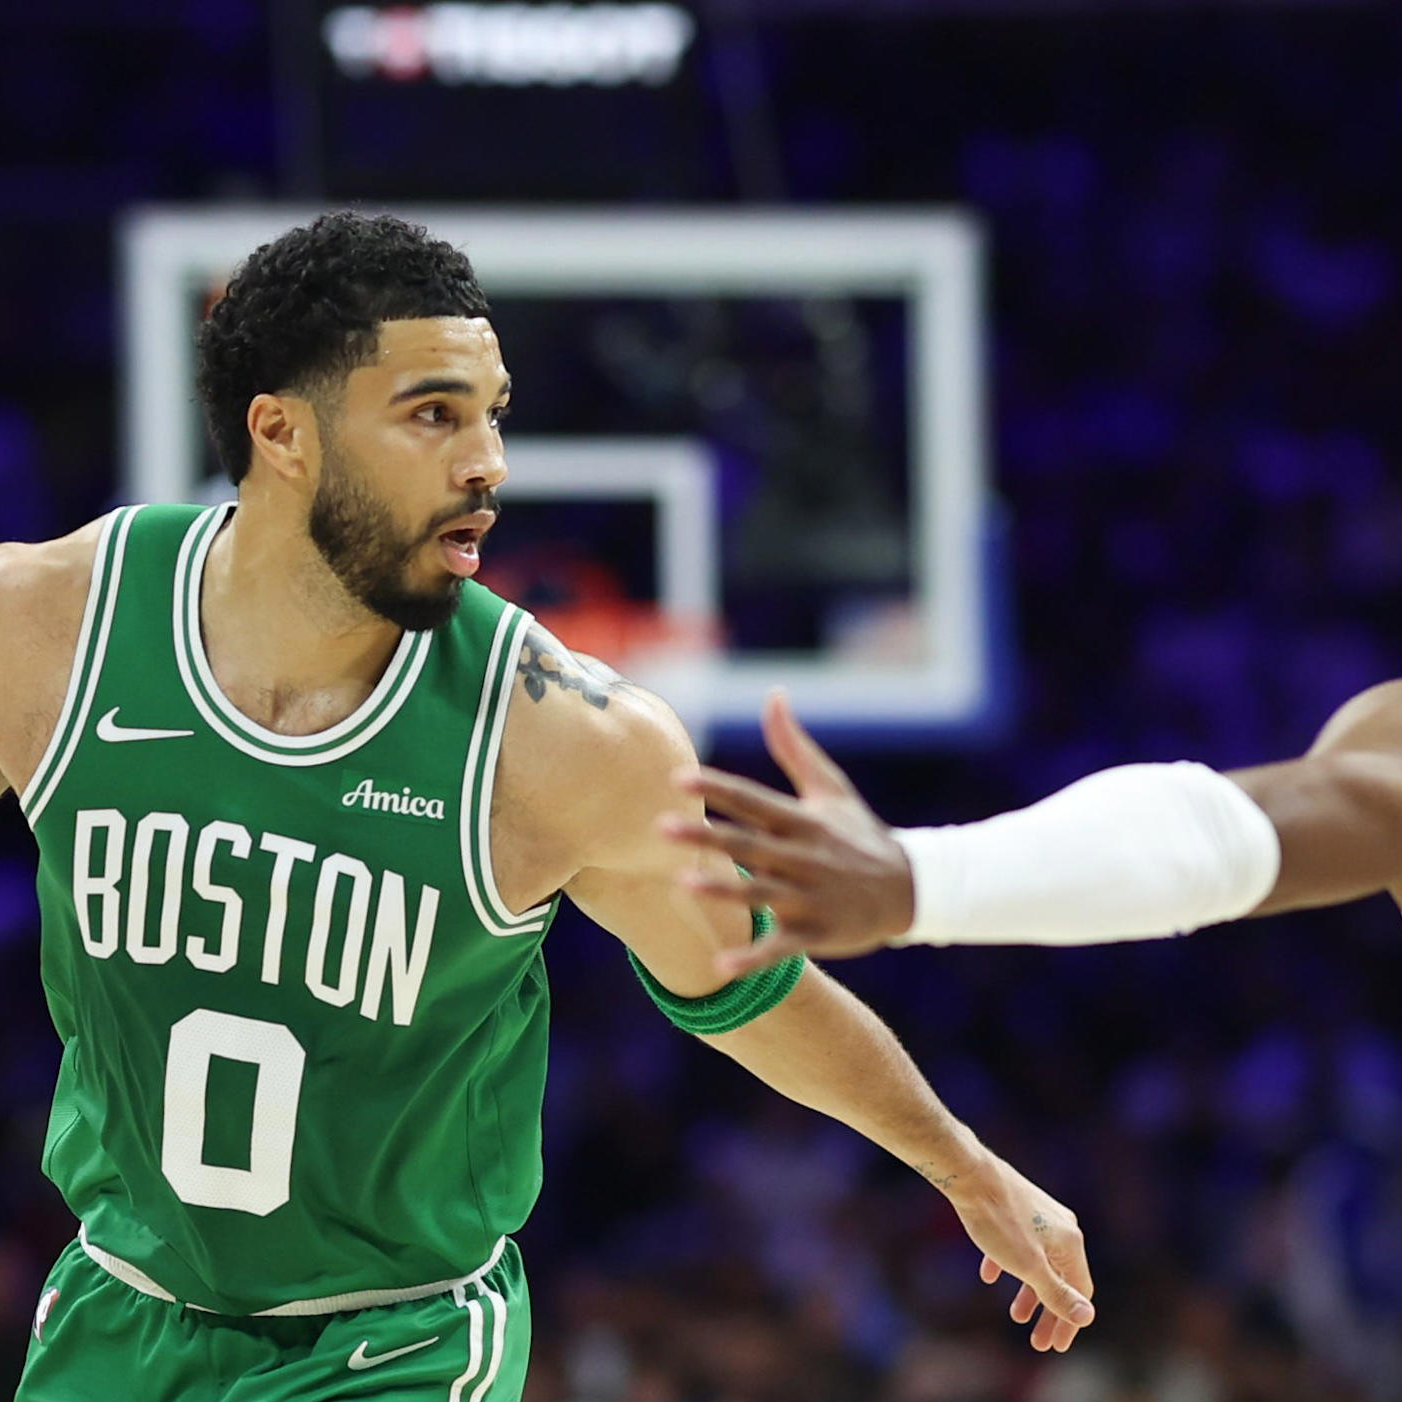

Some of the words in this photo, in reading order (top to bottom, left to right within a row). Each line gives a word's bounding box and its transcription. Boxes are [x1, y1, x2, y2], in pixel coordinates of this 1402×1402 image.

[341, 778, 445, 820] Amica
[73, 808, 441, 1027] BOSTON
[161, 1008, 307, 1217] 0
